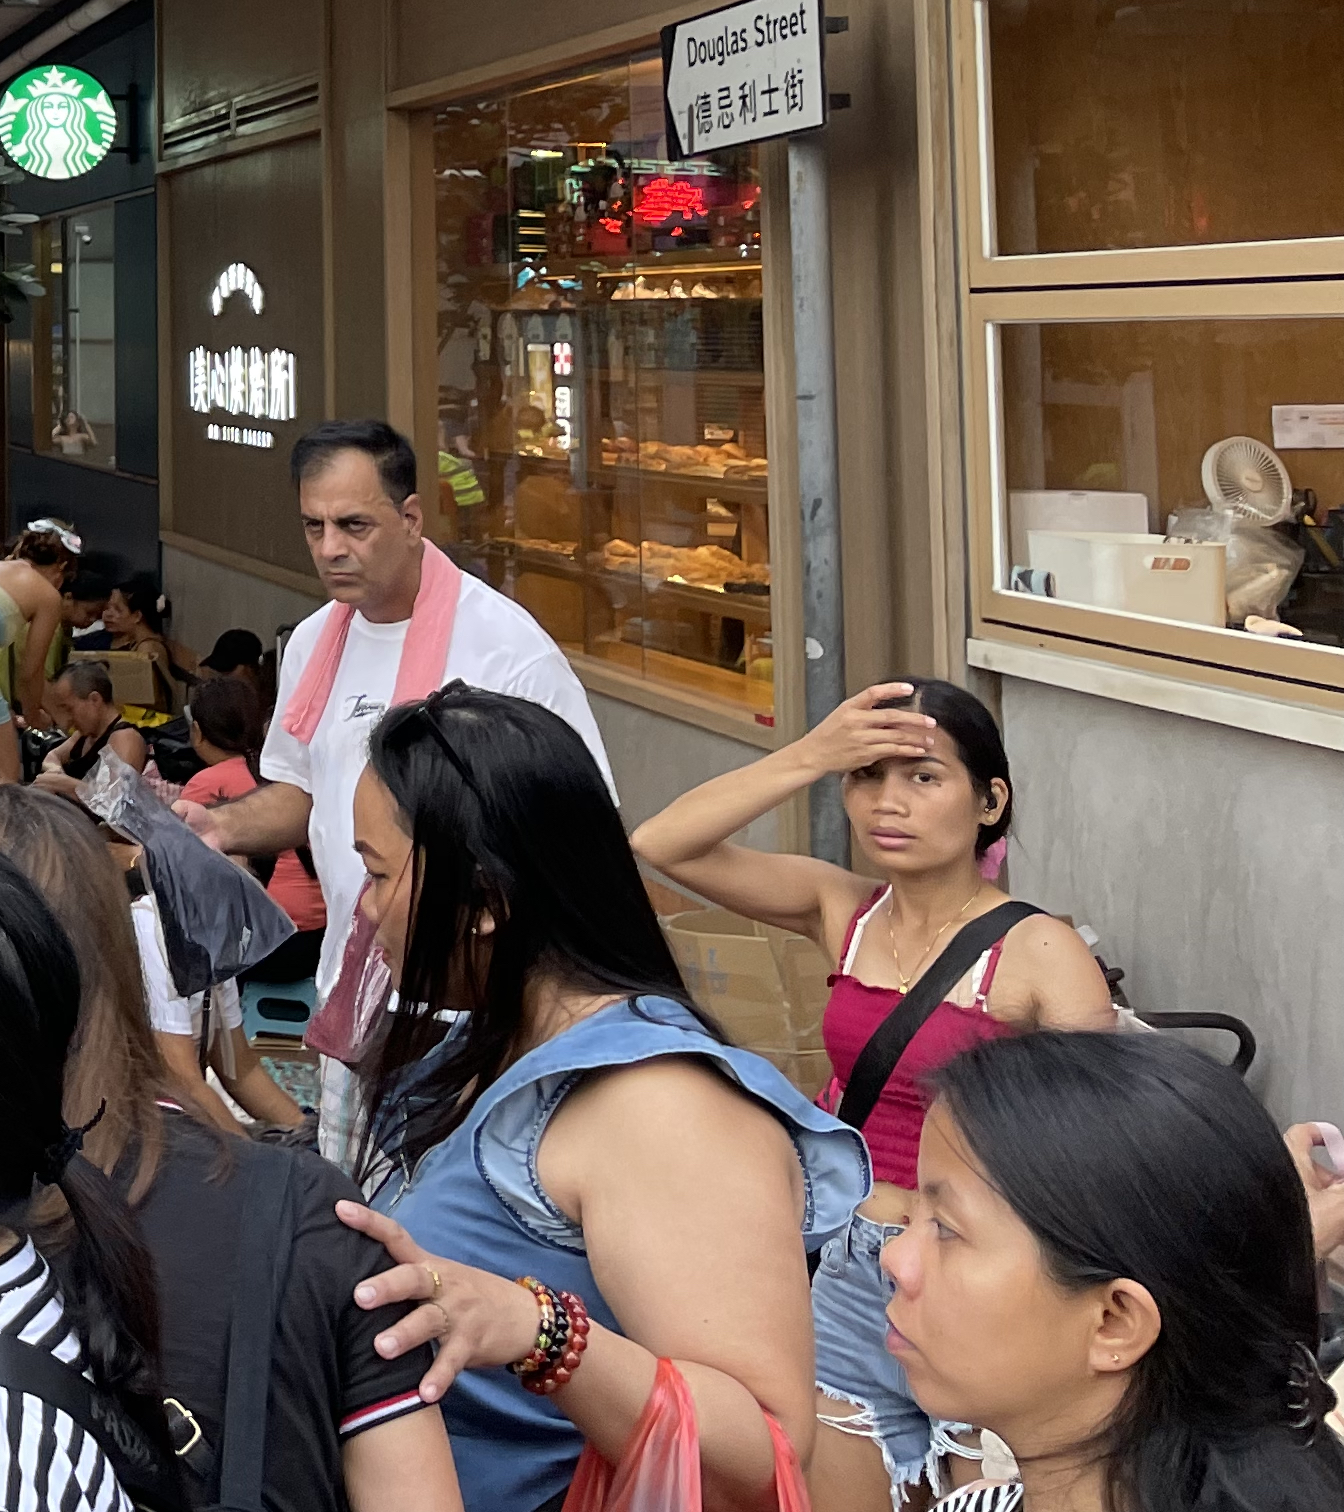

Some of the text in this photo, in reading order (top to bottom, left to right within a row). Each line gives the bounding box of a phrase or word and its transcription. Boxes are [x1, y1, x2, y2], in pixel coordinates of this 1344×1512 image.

[687, 2, 807, 68] Douglas Street
[694, 67, 804, 136] 德忌利士街
